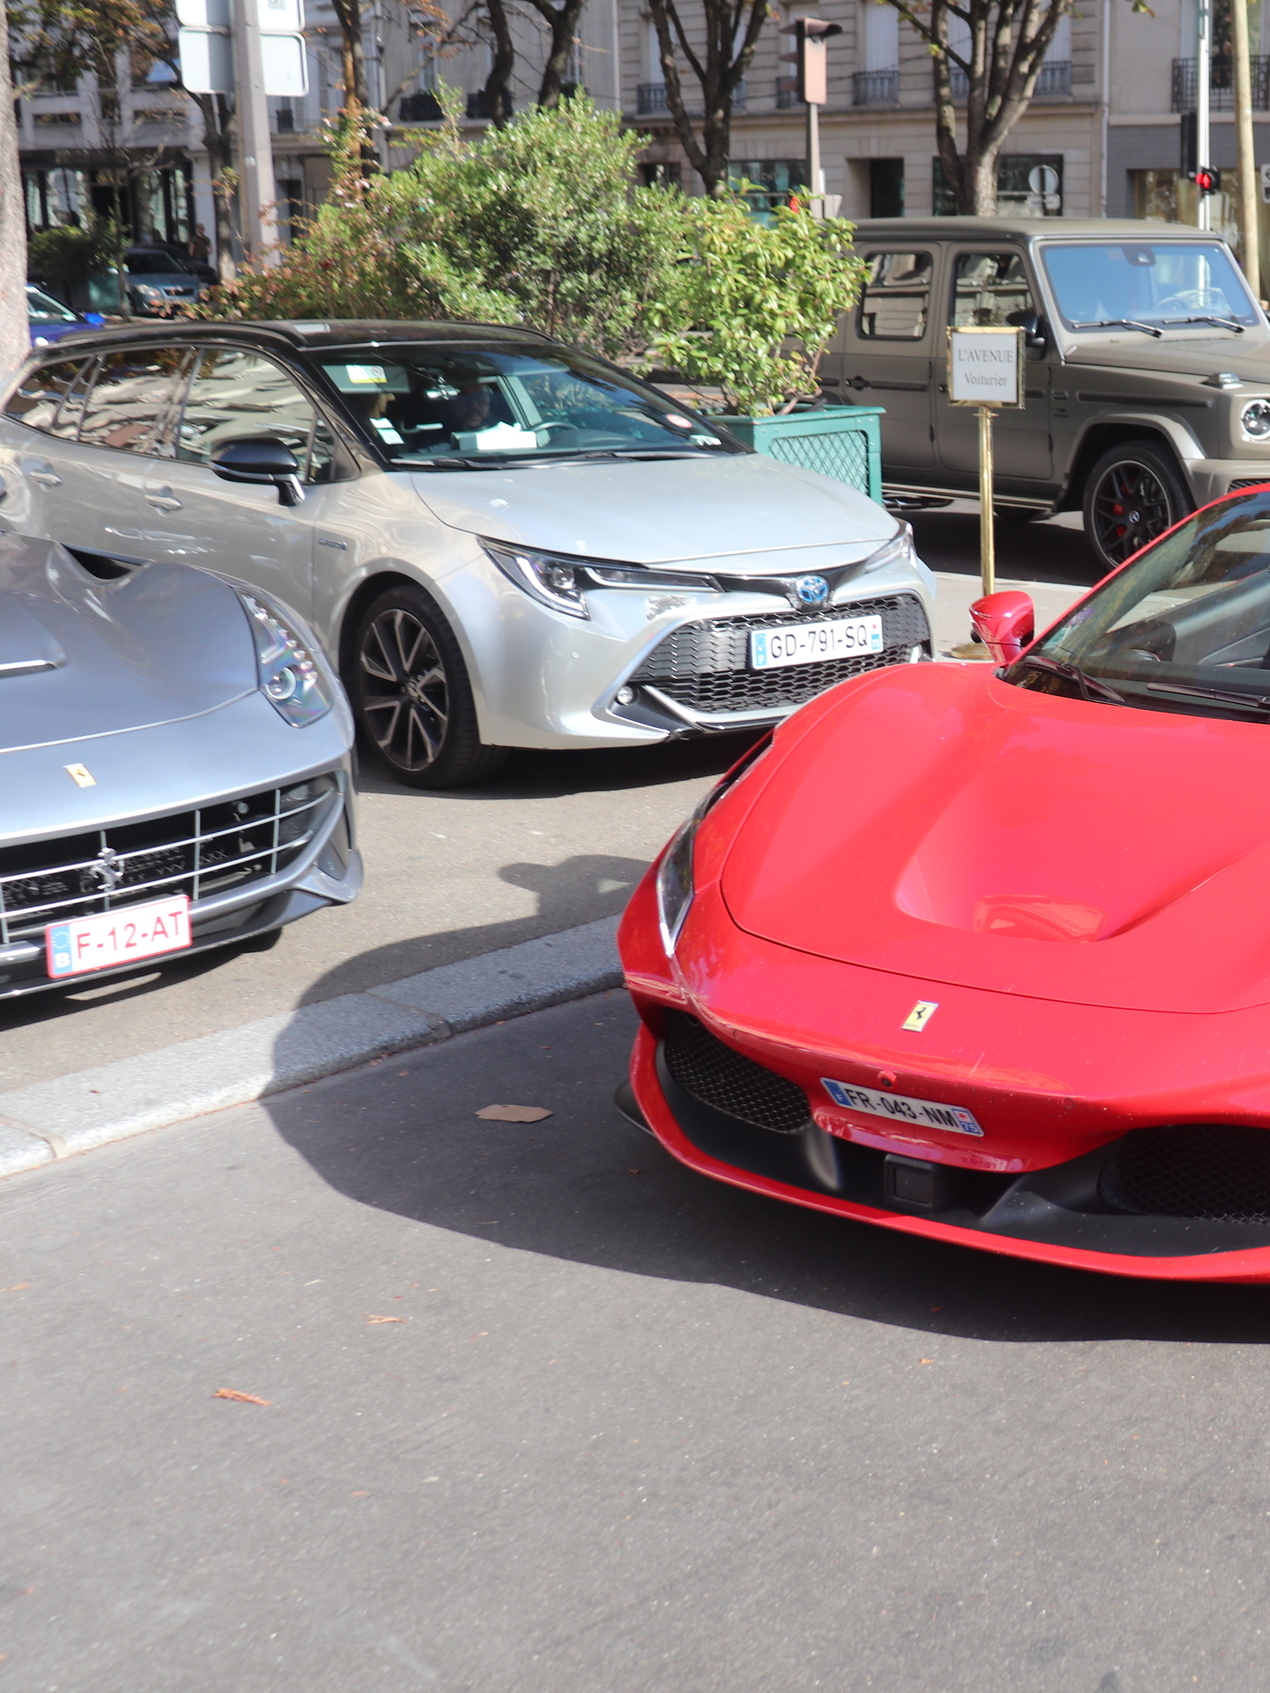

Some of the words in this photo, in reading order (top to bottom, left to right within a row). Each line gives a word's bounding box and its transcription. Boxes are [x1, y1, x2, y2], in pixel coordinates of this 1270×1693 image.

[957, 348, 1015, 363] L'AVENUE
[963, 371, 1008, 387] Voiturier
[770, 624, 868, 659] GD-791-SQ
[76, 910, 183, 959] F-12-AT
[54, 952, 71, 968] B
[843, 1087, 960, 1128] FR-043-NM
[962, 1121, 978, 1133] 75
